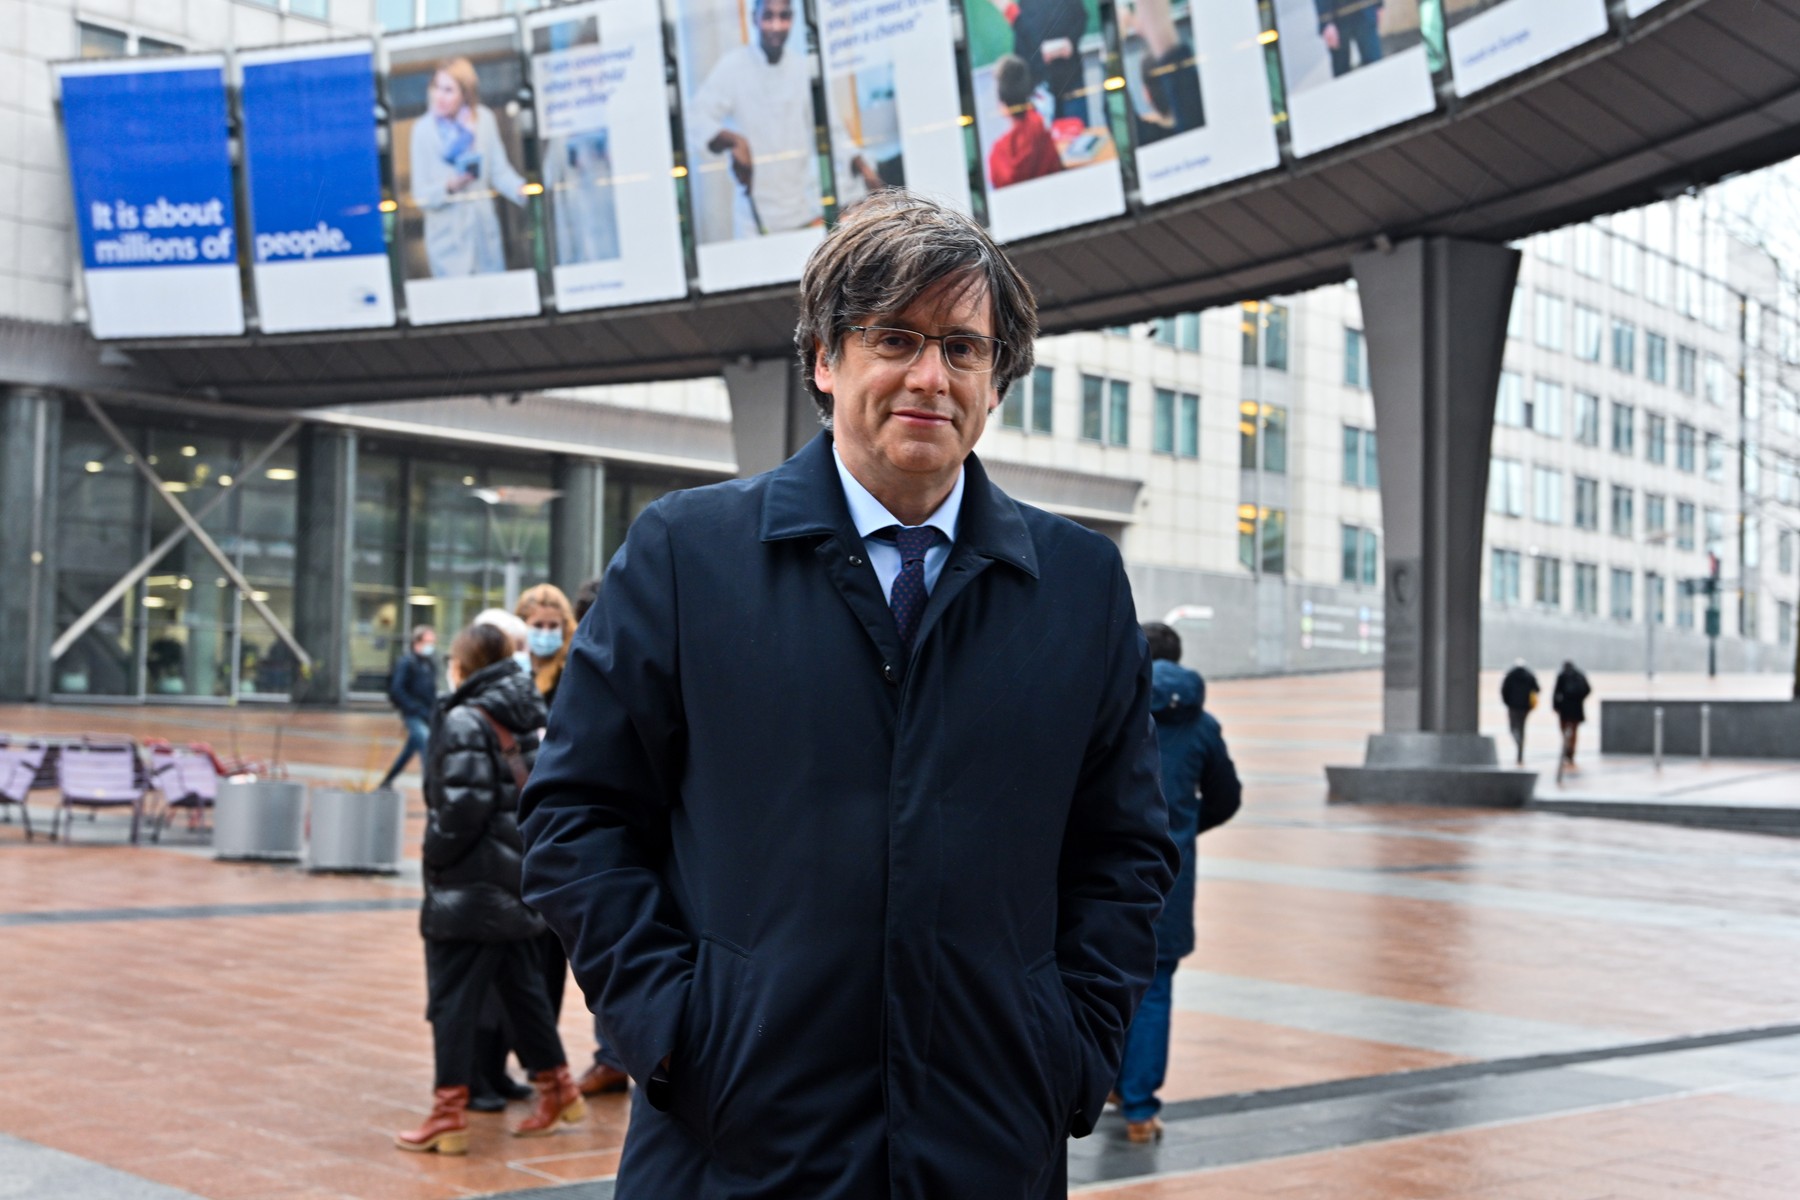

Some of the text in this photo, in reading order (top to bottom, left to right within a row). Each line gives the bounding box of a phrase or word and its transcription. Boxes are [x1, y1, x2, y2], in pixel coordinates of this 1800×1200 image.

[91, 196, 224, 231] It is about
[94, 227, 232, 263] millions of
[255, 221, 352, 262] people.
